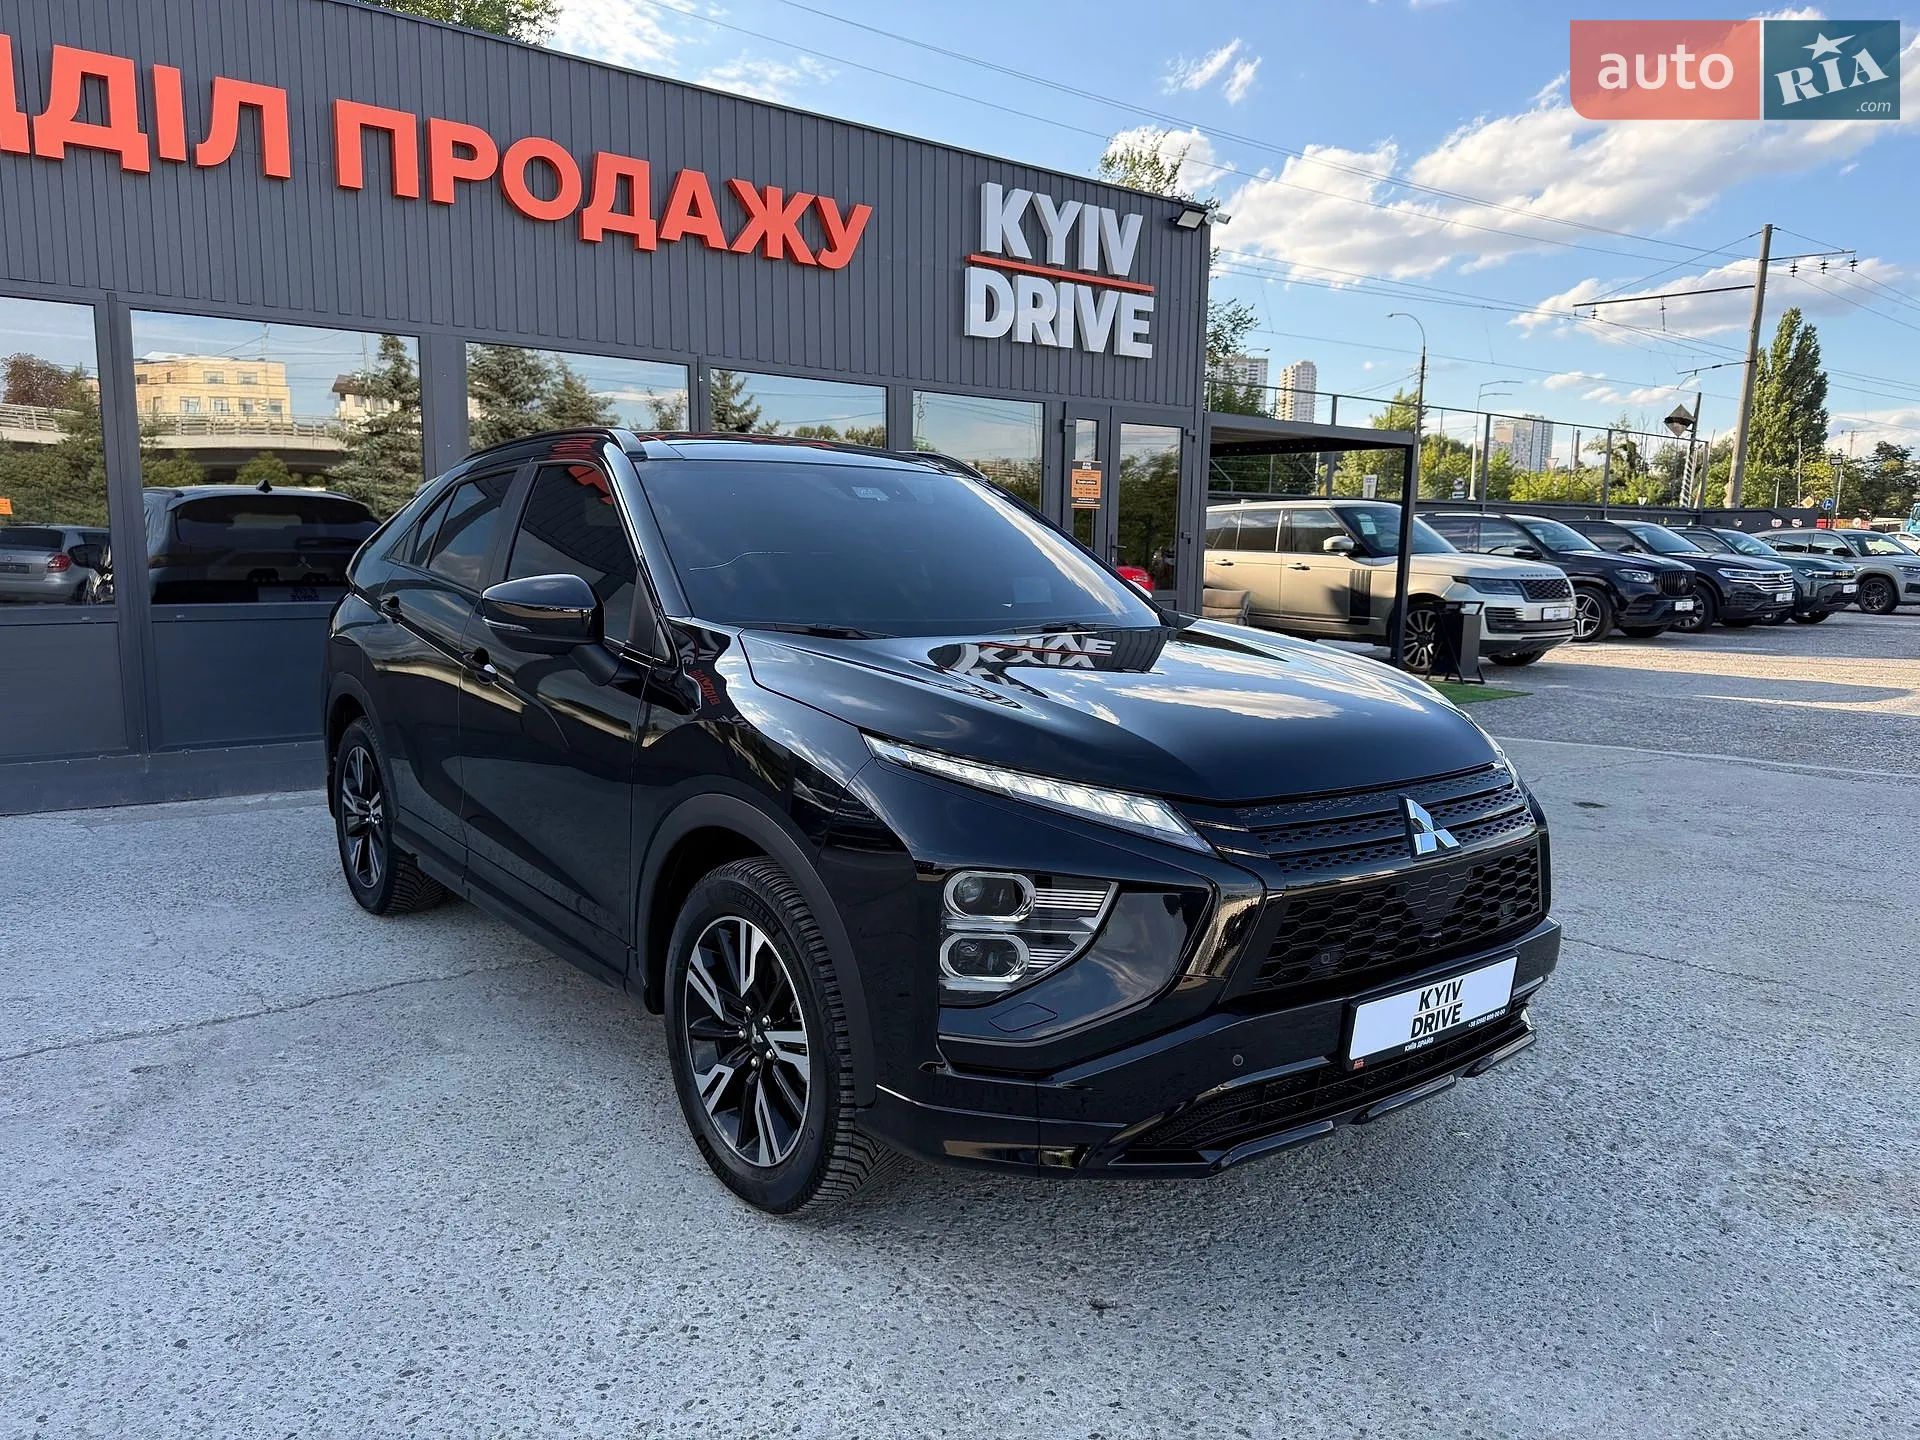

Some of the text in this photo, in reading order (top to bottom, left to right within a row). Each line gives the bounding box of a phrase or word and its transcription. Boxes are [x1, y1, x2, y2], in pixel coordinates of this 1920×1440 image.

[0, 33, 873, 270] ДІЛ ПРОДАЖУ
[981, 182, 1143, 276] KYIV
[964, 266, 1154, 359] DRIVE
[1410, 1002, 1463, 1039] DRIVE
[1418, 978, 1464, 1012] KYIV
